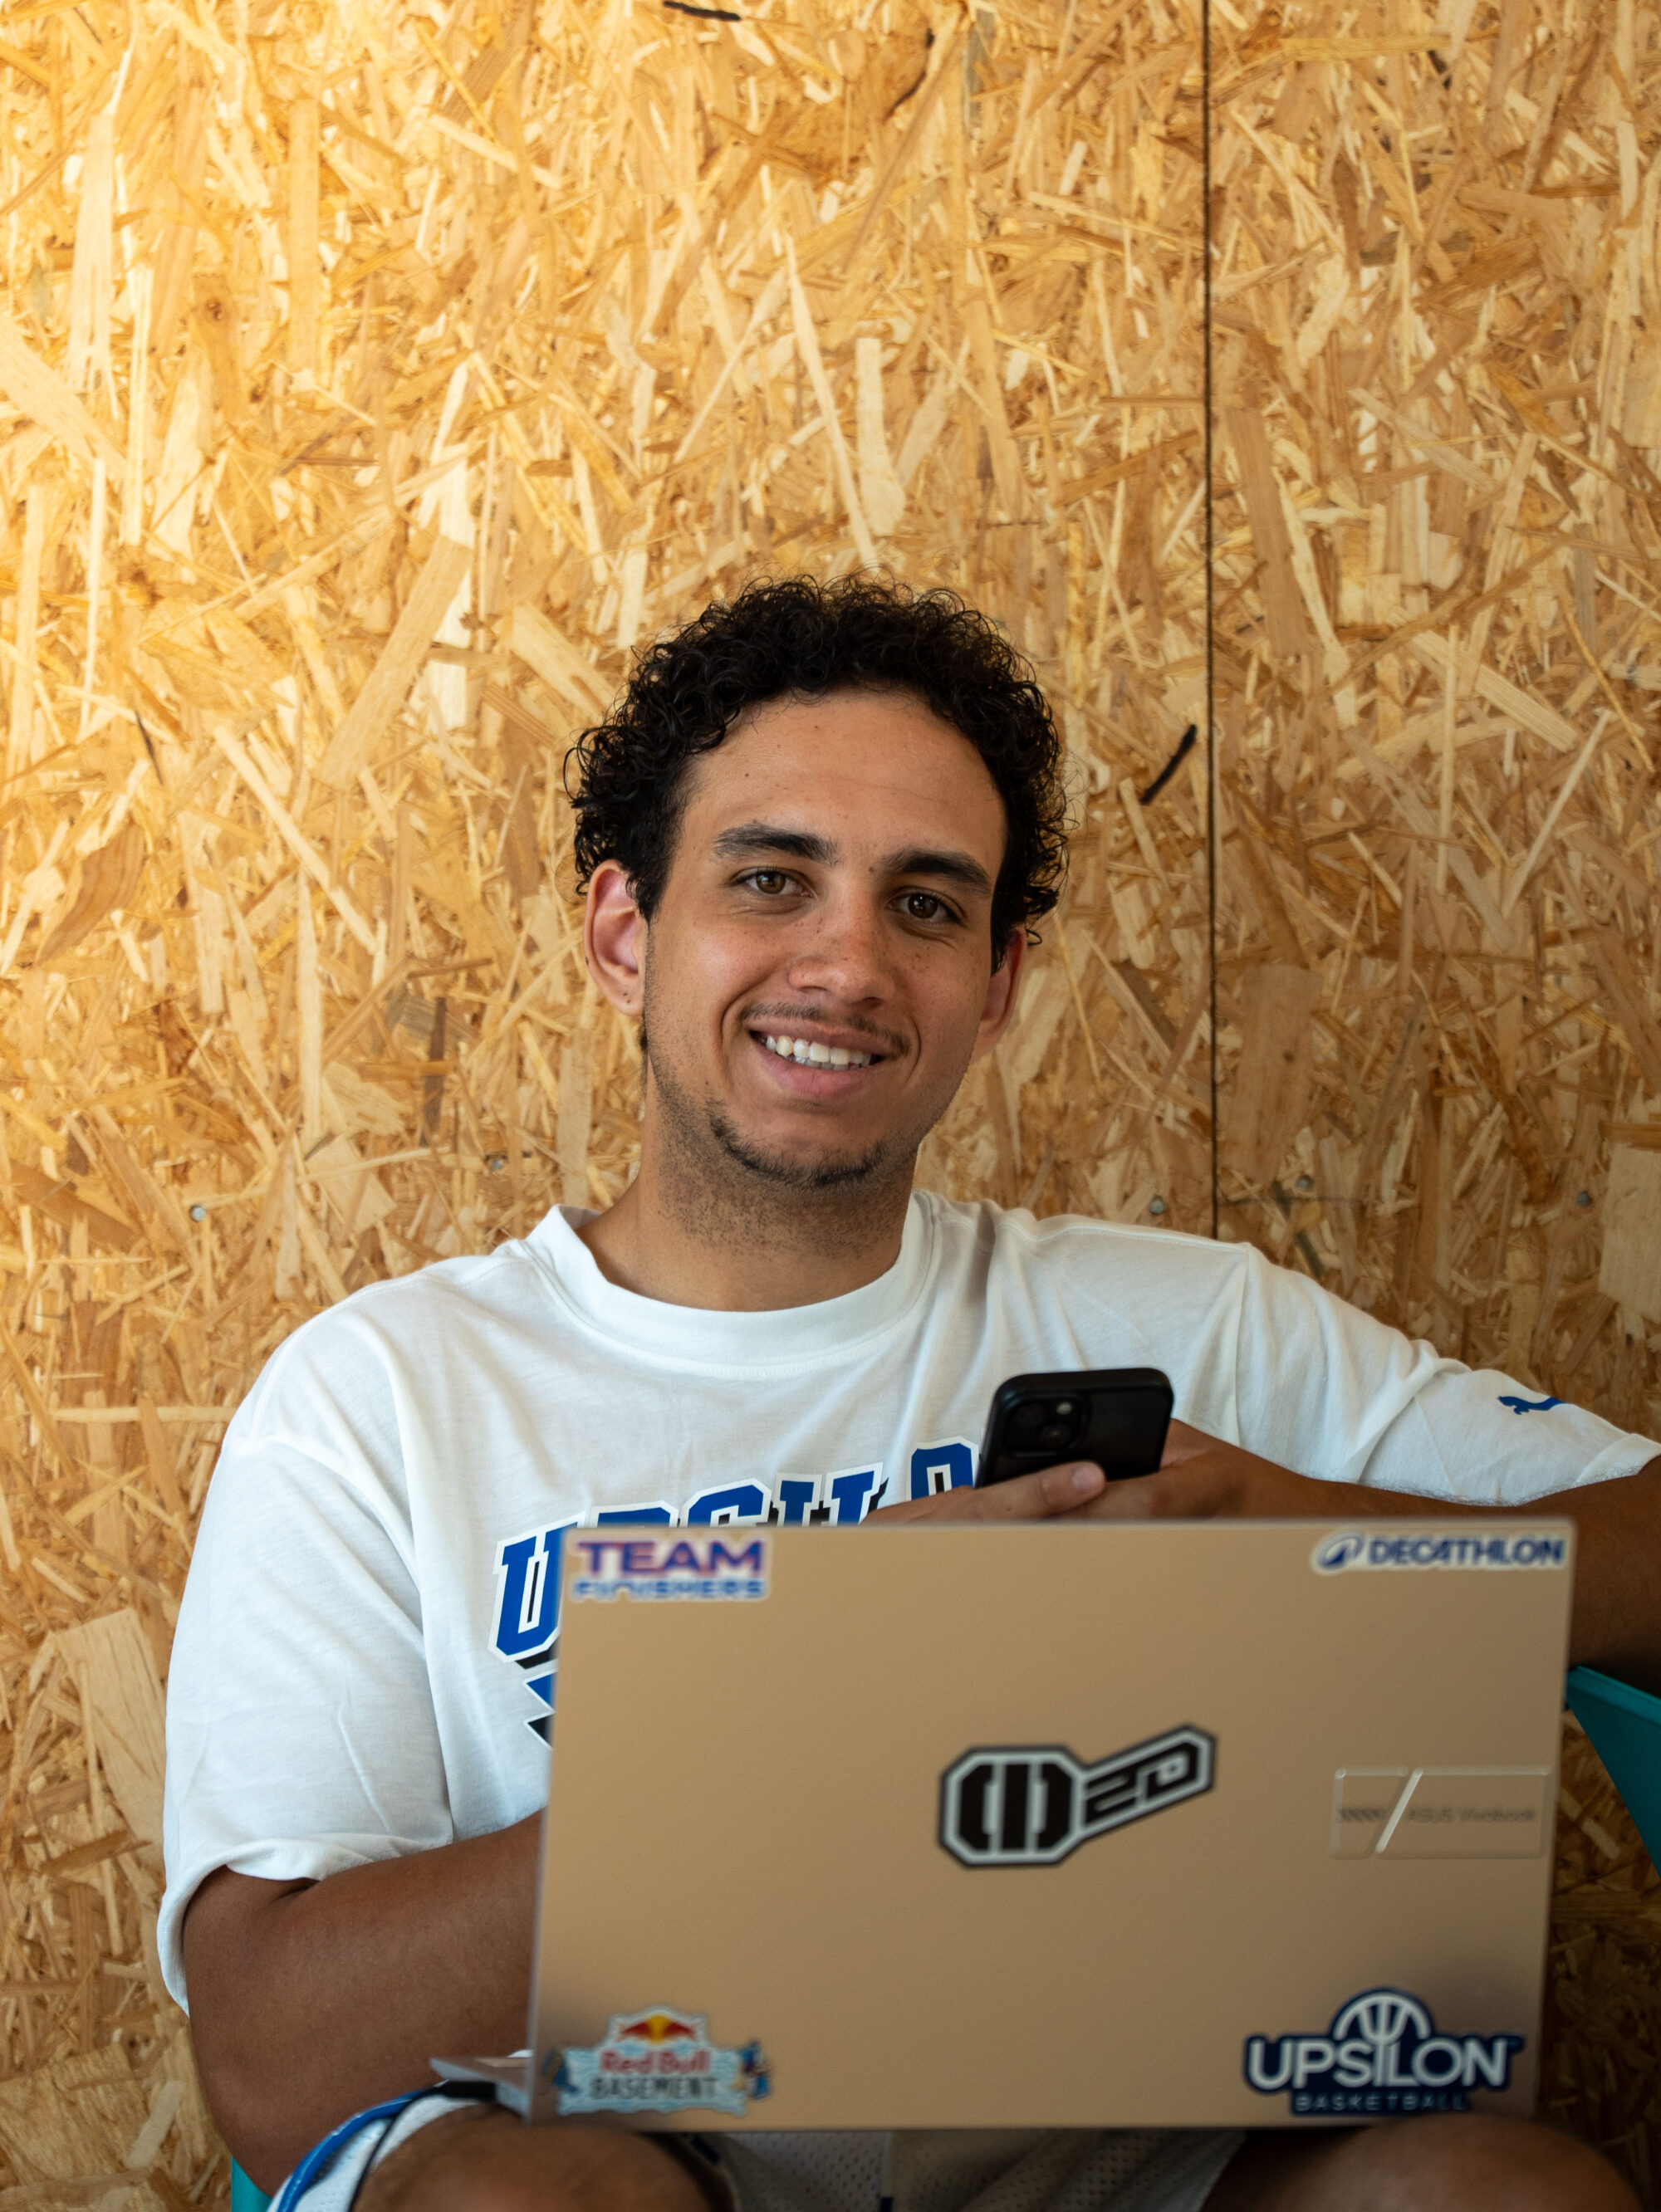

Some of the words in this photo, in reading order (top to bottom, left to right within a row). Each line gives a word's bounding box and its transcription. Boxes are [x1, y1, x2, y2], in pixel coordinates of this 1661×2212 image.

[576, 1540, 764, 1574] TEAM
[1370, 1539, 1566, 1565] DECATHLON
[600, 2050, 651, 2073] Red
[659, 2050, 710, 2073] Bull
[1247, 2037, 1508, 2089] UPSILON
[1295, 2092, 1466, 2112] BASKETBALL
